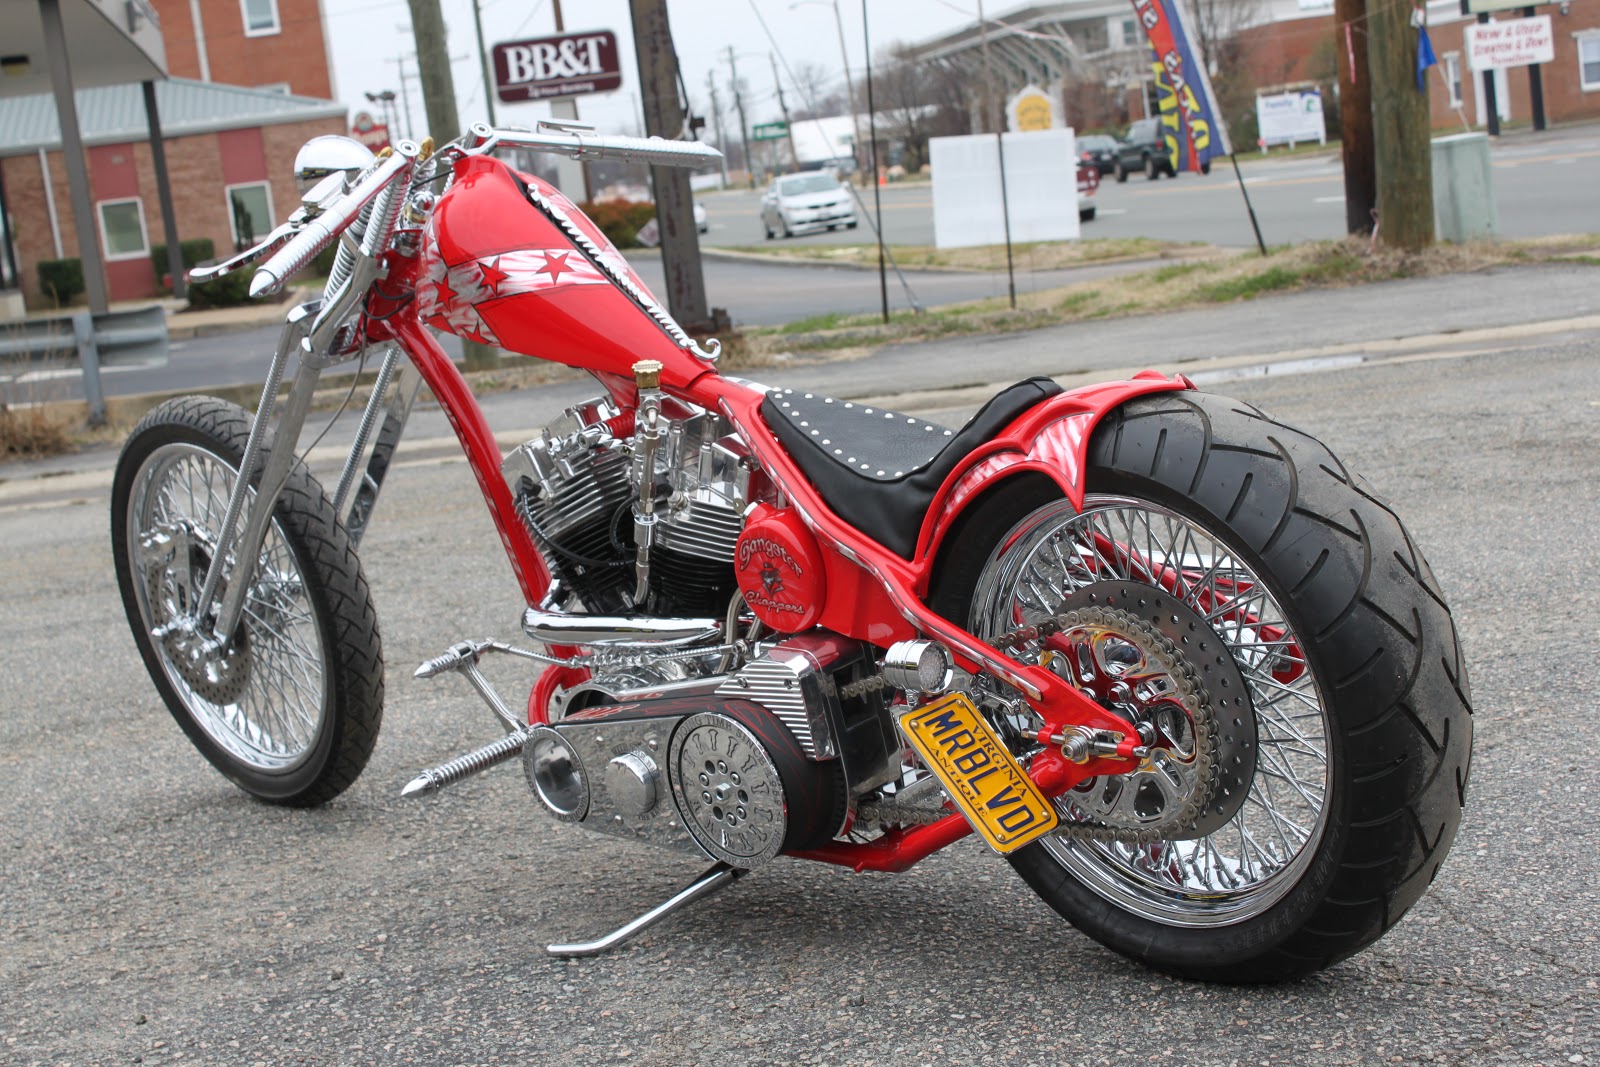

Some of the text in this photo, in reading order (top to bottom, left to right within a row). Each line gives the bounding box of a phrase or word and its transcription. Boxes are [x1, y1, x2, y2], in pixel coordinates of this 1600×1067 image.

[502, 36, 608, 84] BB&T
[740, 538, 803, 577] Gangster
[746, 591, 804, 613] Choppers
[705, 715, 732, 731] TIME
[736, 728, 766, 766] SINCE
[973, 725, 1027, 797] VIRGINIA
[933, 749, 988, 817] ANTIQUE
